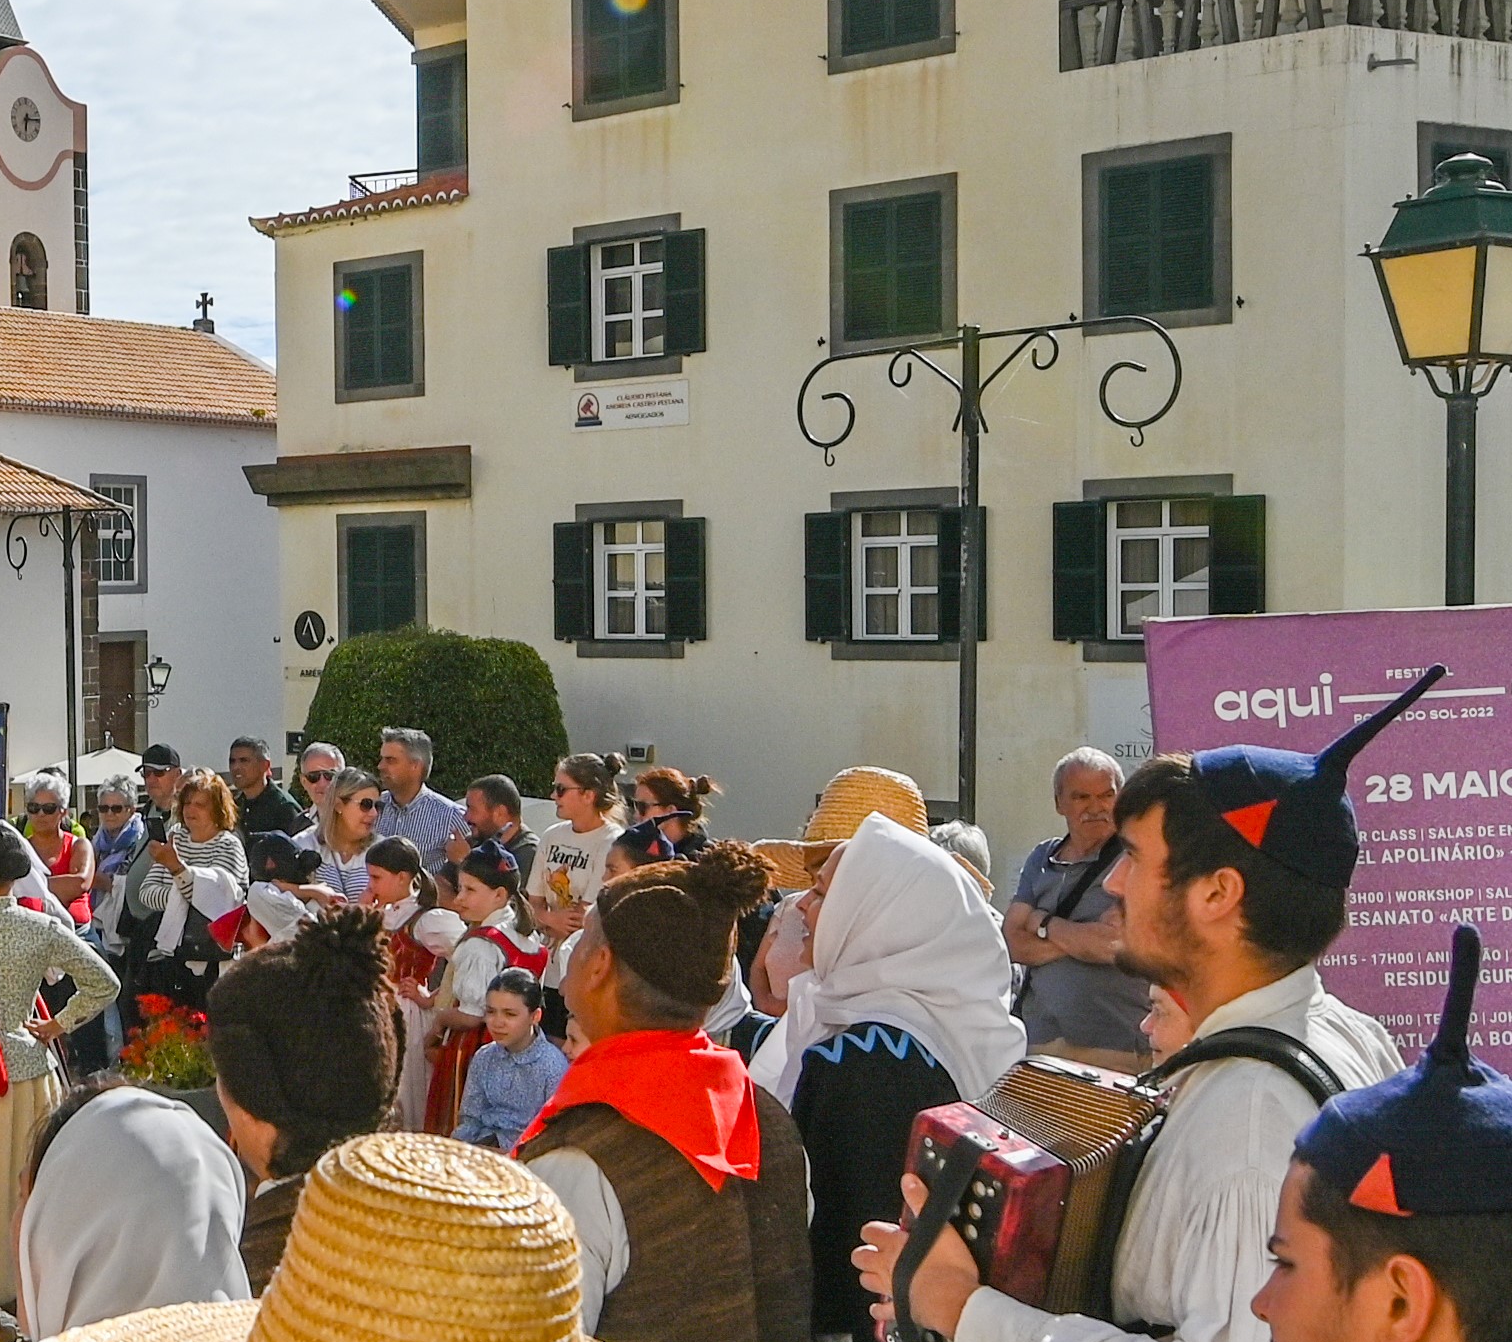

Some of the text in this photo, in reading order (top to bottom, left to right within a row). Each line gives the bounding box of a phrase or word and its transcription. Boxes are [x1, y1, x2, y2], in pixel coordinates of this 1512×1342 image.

[300, 666, 322, 678] AMÉR
[1386, 668, 1454, 679] FESTIL
[1214, 673, 1332, 728] aqui
[1405, 711, 1426, 721] DO
[1430, 709, 1457, 719] SOL
[1461, 707, 1493, 718] 2022
[1366, 774, 1412, 802] 28
[1372, 829, 1416, 841] CLASS
[1429, 827, 1473, 839] SALAS
[1478, 826, 1495, 837] DE
[546, 844, 590, 871] Bambi
[1356, 851, 1376, 865] EL
[1350, 892, 1383, 904] 3H00
[1396, 889, 1473, 902] WORKSHOP
[1349, 909, 1433, 926] ESANATO
[1372, 953, 1413, 964] 17H00
[1426, 947, 1502, 964] ANIÃO
[1385, 971, 1449, 986] RESIDU
[1380, 1014, 1412, 1026] 8H00
[1424, 1011, 1478, 1025] TEO
